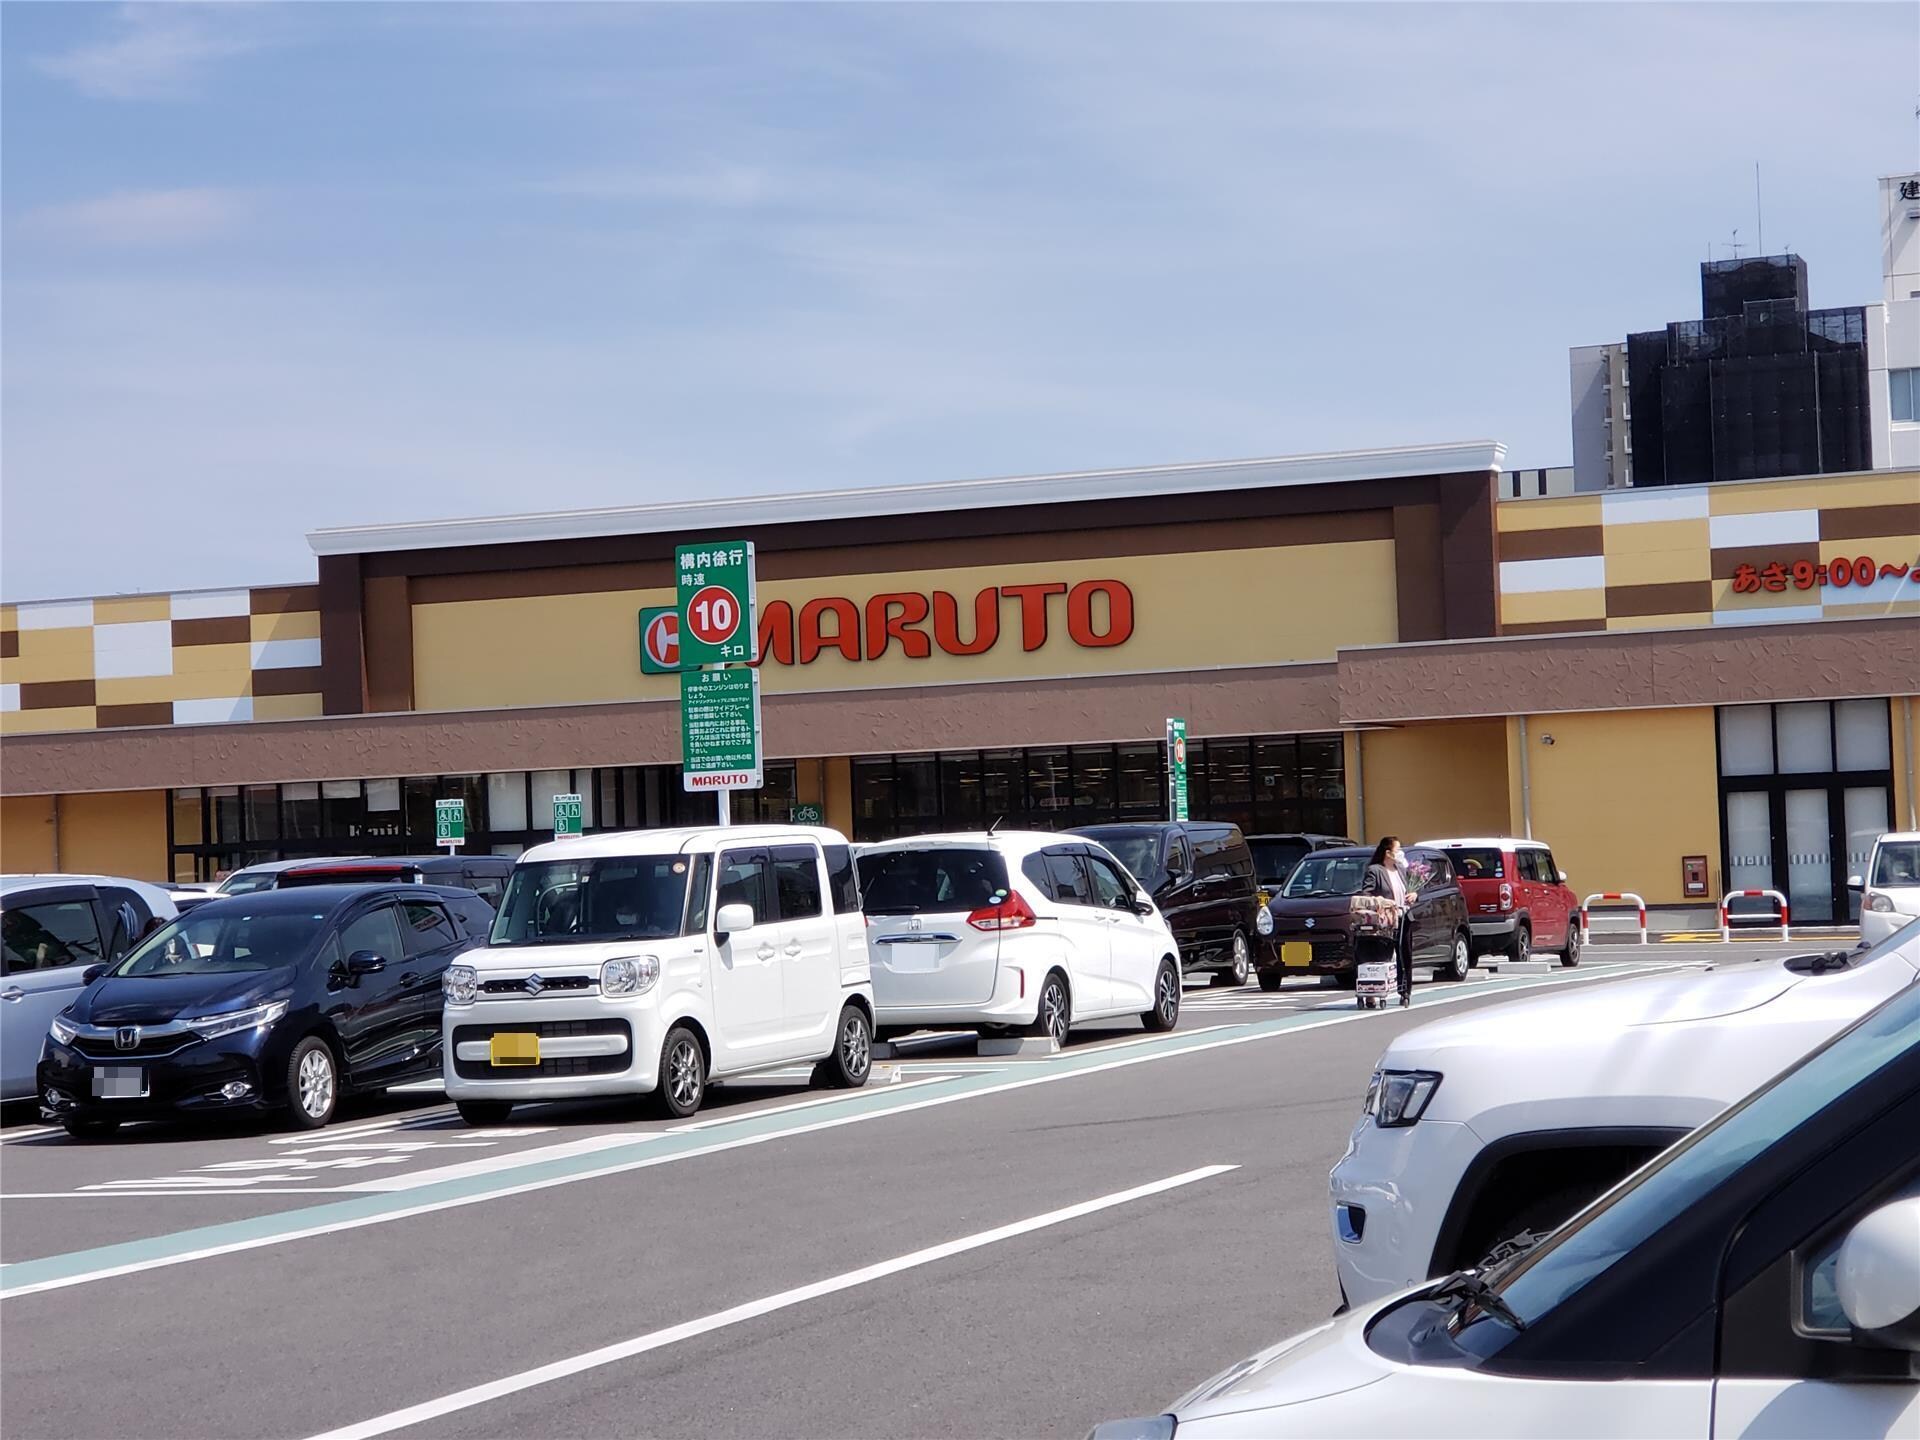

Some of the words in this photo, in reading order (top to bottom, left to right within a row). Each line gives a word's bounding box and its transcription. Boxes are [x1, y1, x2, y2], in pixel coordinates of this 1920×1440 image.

[680, 549, 743, 569] 構内徐行
[681, 573, 705, 587] 時速
[1732, 555, 1920, 594] あさ9:00～
[695, 598, 732, 631] 10
[724, 579, 1135, 668] MARUTO
[720, 644, 744, 658] キロ
[701, 673, 732, 683] お願い
[692, 774, 749, 787] MARUTO
